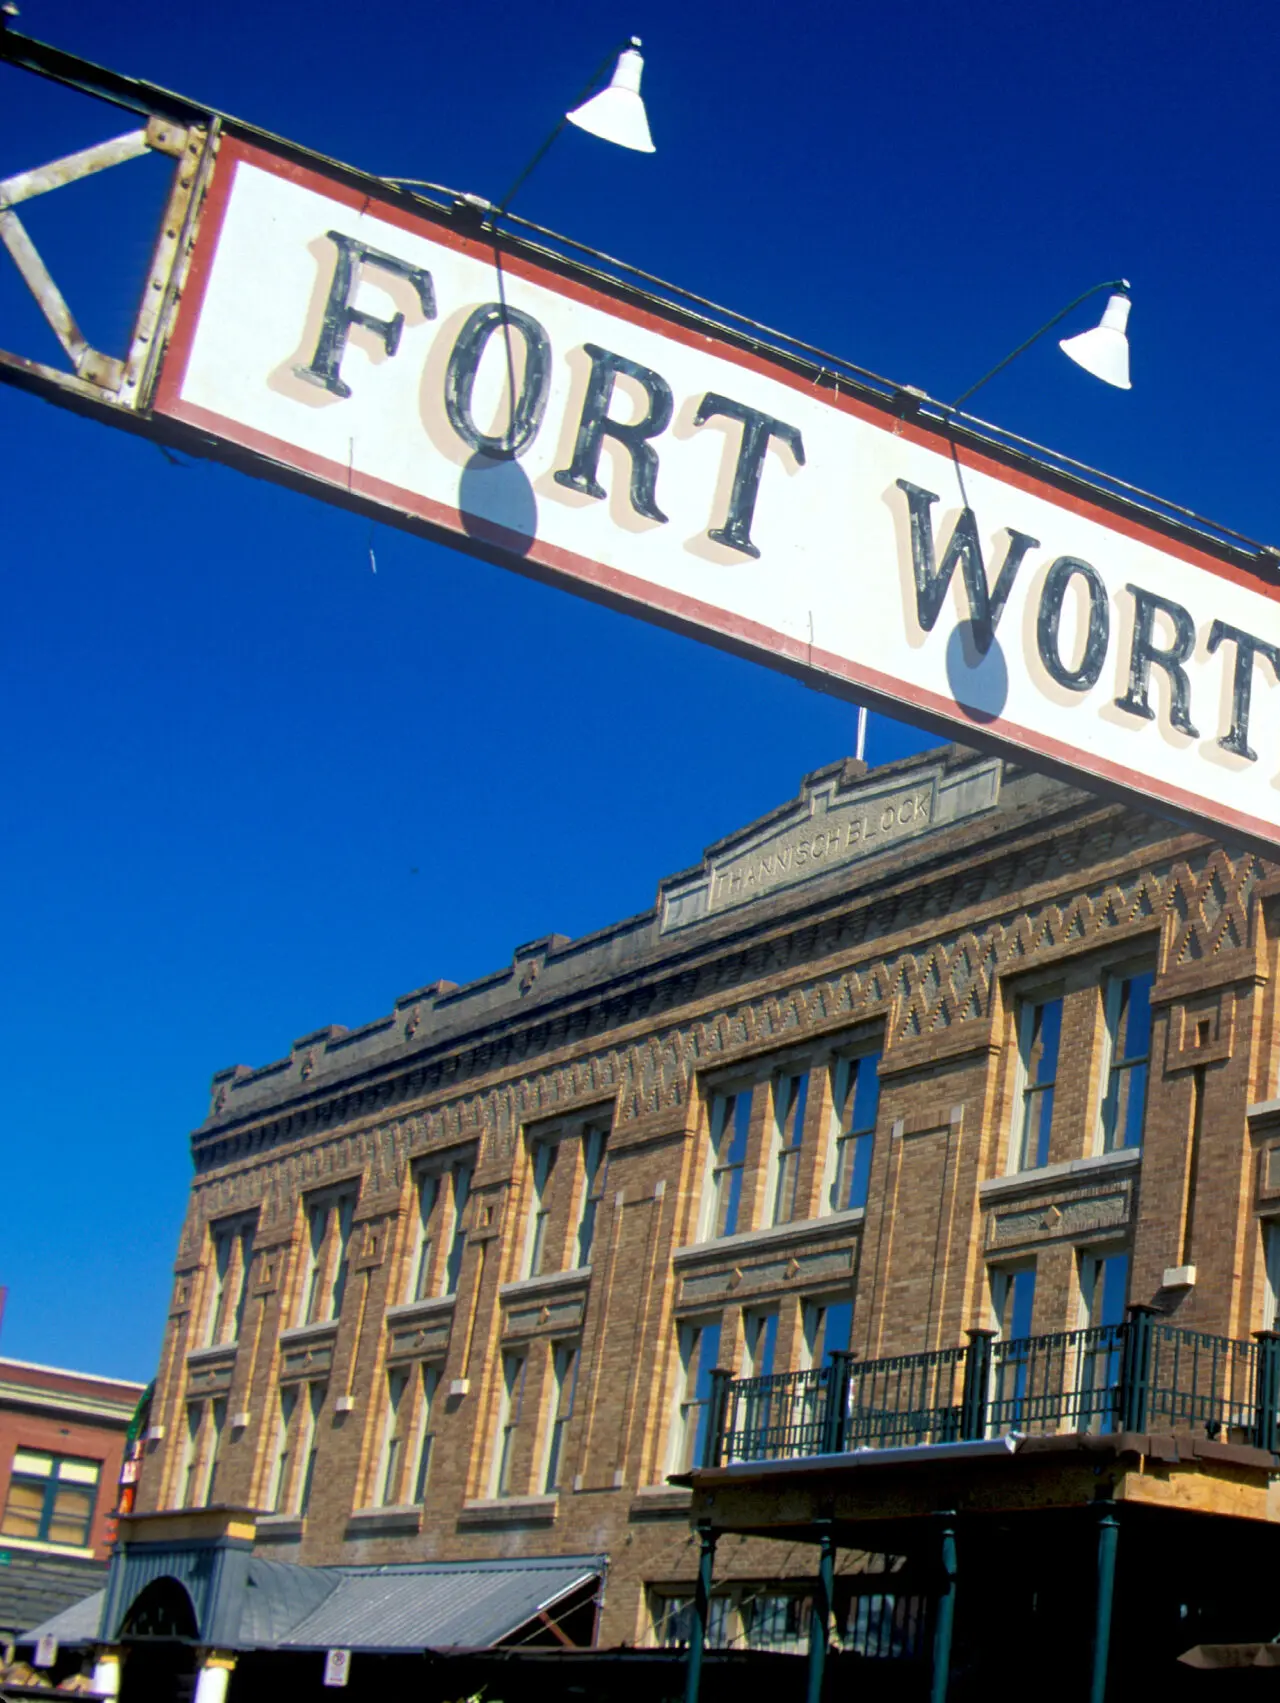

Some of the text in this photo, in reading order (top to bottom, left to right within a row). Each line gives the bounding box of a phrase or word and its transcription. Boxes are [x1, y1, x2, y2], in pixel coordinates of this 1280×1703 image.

[293, 230, 806, 560] FORT
[715, 791, 932, 898] THANNISCH BLOCK
